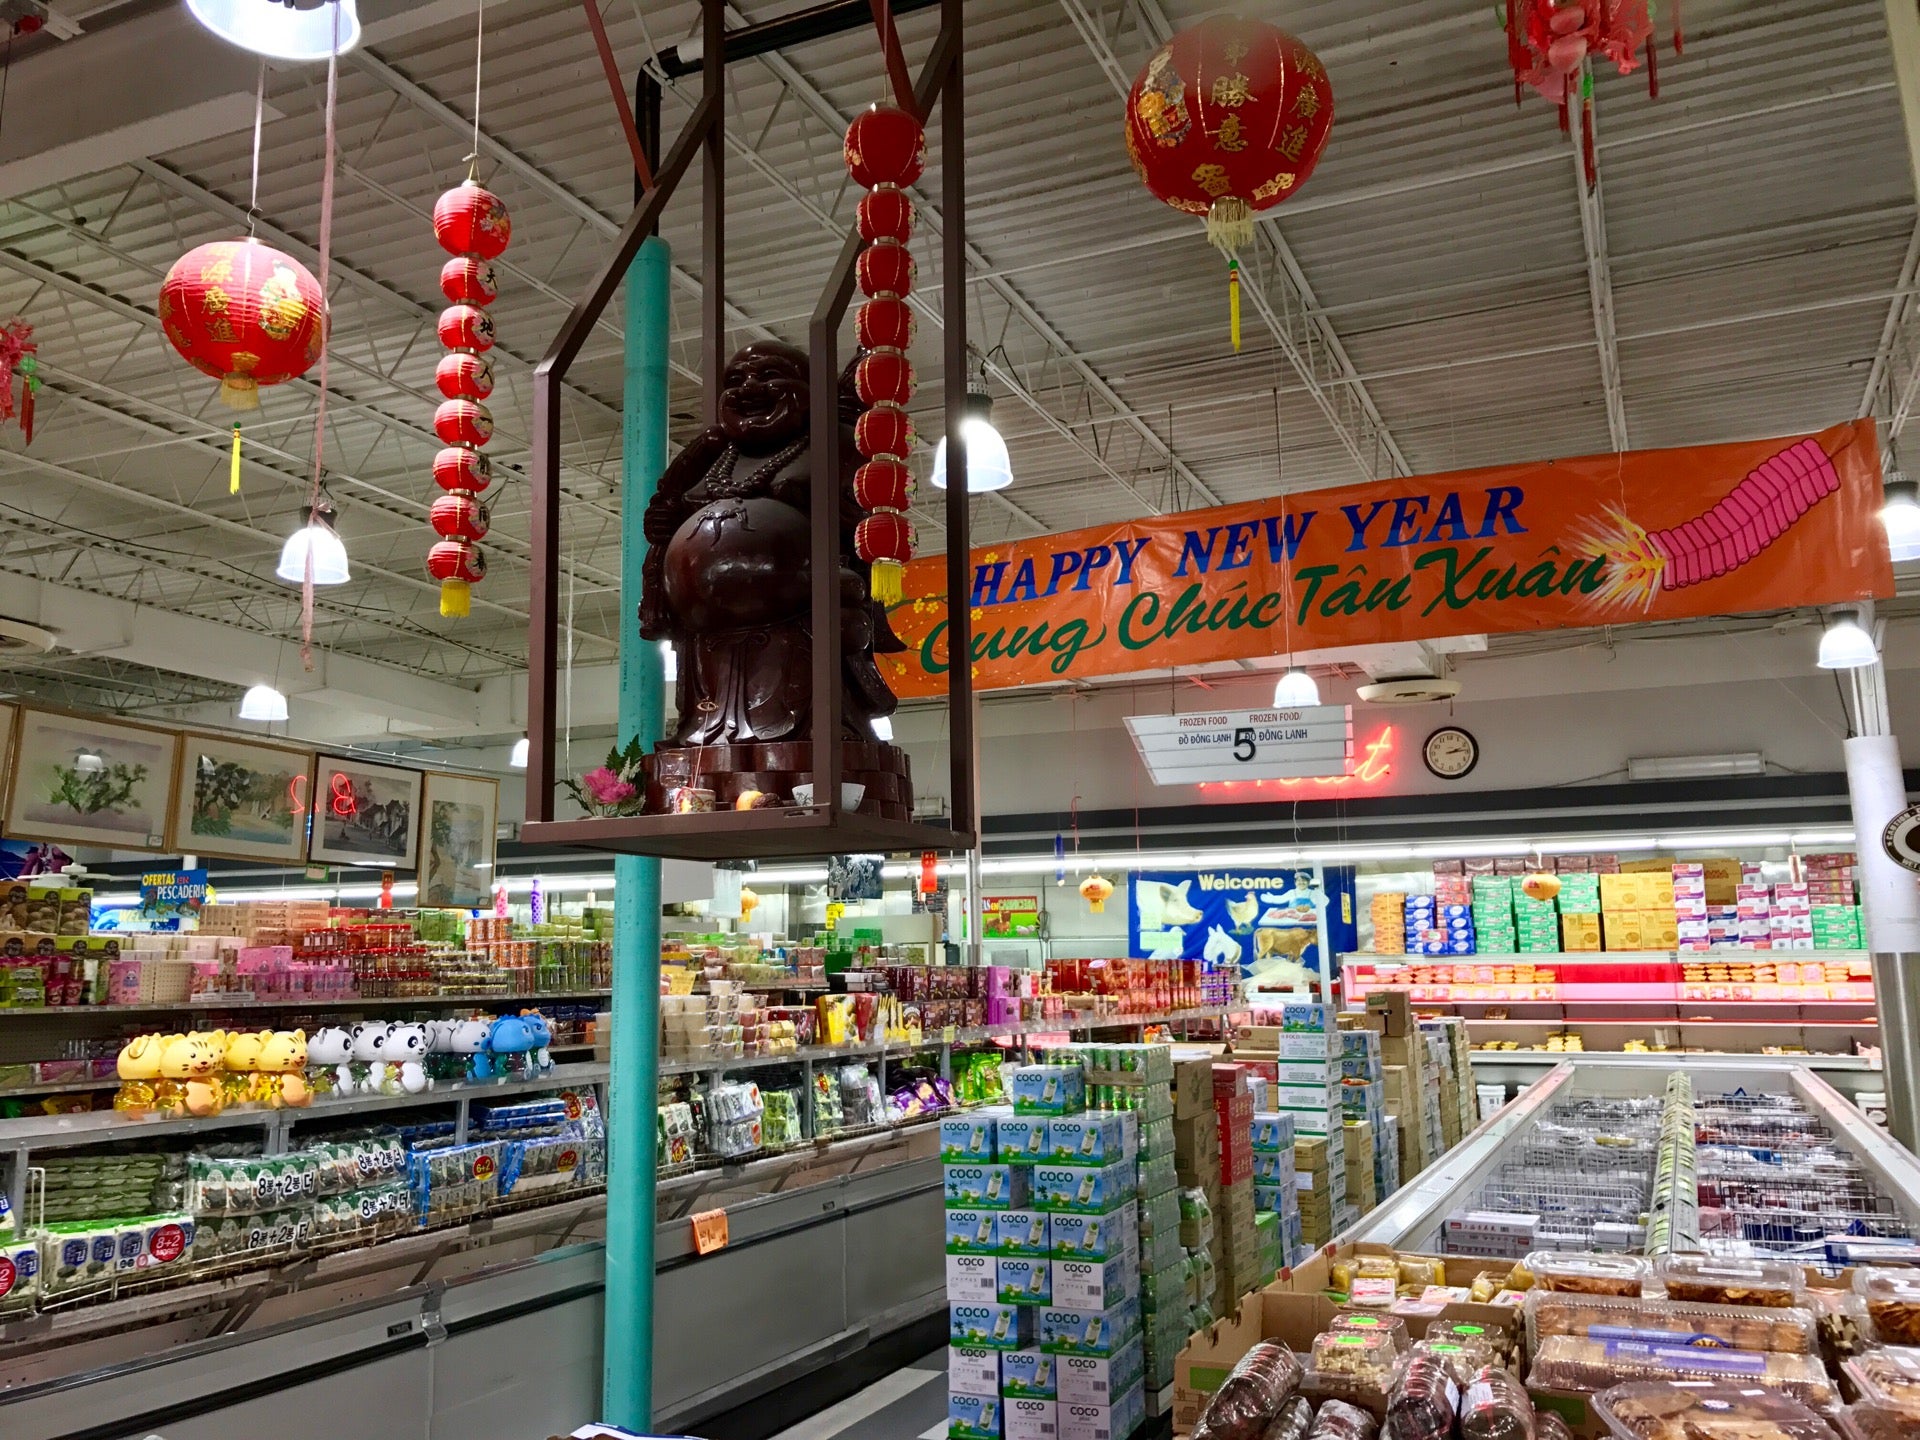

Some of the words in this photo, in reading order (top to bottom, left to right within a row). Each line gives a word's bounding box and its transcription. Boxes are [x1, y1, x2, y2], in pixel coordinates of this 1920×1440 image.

[969, 537, 1152, 608] HAPPY
[1172, 510, 1319, 580] NEW
[1340, 485, 1529, 553] YEAR
[1117, 581, 1283, 651] Chúc
[1294, 563, 1412, 626] Tân
[1413, 545, 1608, 618] Xuân
[1179, 716, 1207, 727] FROZEN
[1208, 715, 1228, 726] FOOD
[1249, 712, 1277, 723] FROZEN
[1233, 727, 1256, 762] 5
[142, 873, 175, 886] OFERTAS
[1198, 873, 1284, 891] Welcome
[1284, 1006, 1306, 1014] COCO
[1016, 1074, 1043, 1082] COCO
[944, 1123, 970, 1131] COCO
[1000, 1123, 1028, 1132] COCO
[1053, 1123, 1081, 1133] COCO
[476, 1159, 491, 1173] 6+2
[949, 1169, 983, 1179] COCO
[1039, 1171, 1074, 1182] COCO
[950, 1212, 977, 1222] COCO
[1001, 1214, 1028, 1224] COCO
[1054, 1217, 1083, 1227] COCO
[155, 1232, 181, 1249] 8+2
[957, 1258, 985, 1267] COCO
[1001, 1261, 1029, 1271] COCO
[1063, 1263, 1092, 1274] COCO
[955, 1307, 990, 1319] COCO
[1045, 1312, 1080, 1325] COCO
[960, 1348, 987, 1358] COCO
[1006, 1354, 1035, 1364] COCO
[1068, 1358, 1097, 1369] COCO
[952, 1396, 979, 1406] COCO
[1016, 1401, 1045, 1411] COCO
[1070, 1406, 1099, 1417] COCO
